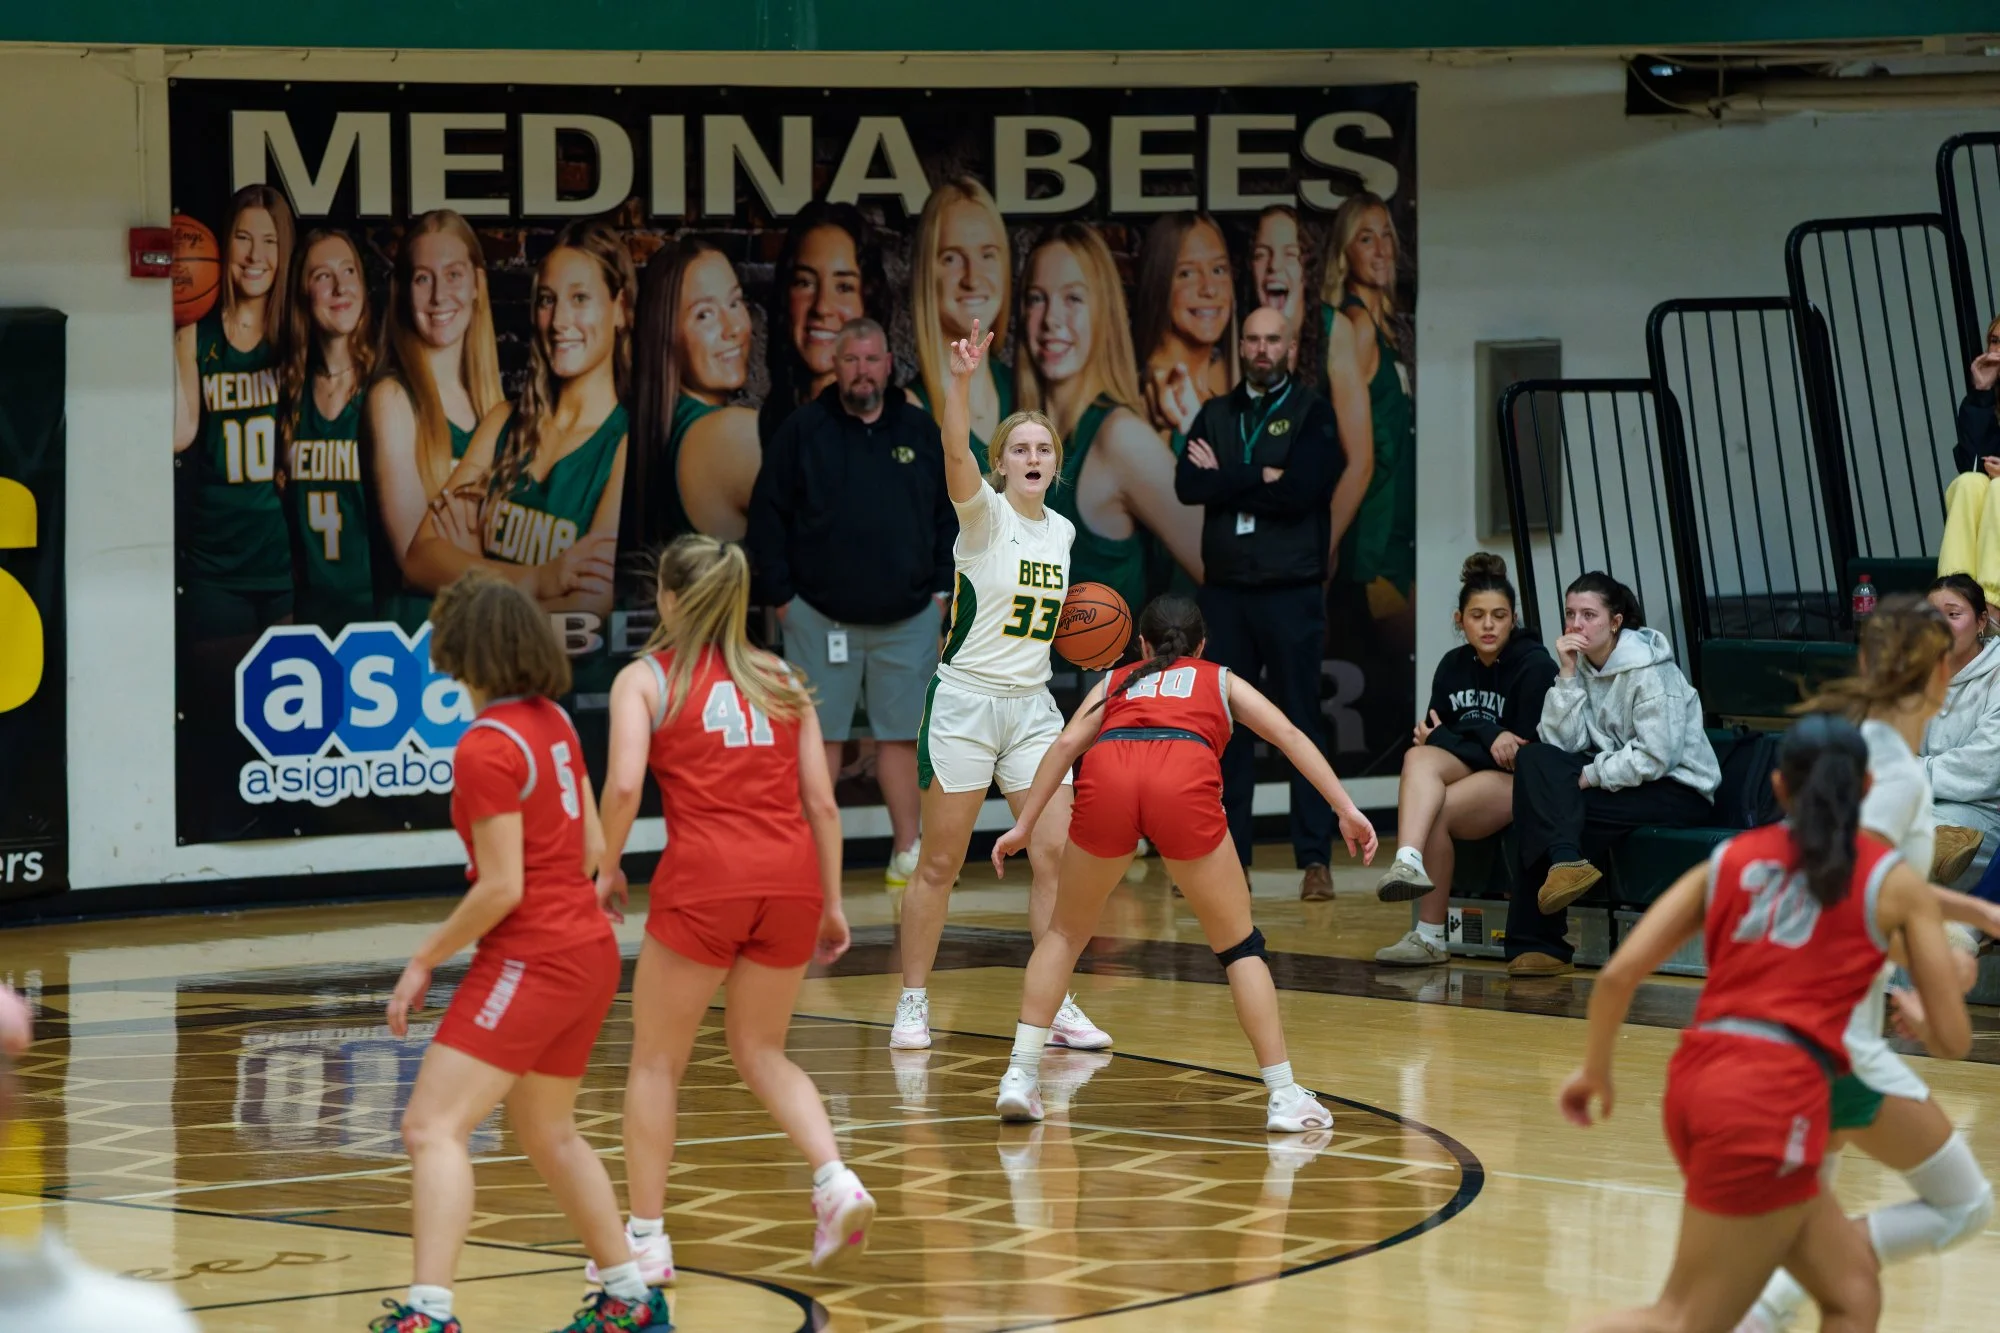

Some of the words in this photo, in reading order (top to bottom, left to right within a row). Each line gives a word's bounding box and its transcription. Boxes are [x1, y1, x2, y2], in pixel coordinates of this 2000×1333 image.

[229, 109, 931, 219] MEDINA
[993, 110, 1401, 214] BEES
[202, 367, 281, 413] MEDIN
[222, 414, 276, 485] 10
[306, 490, 343, 561] 4
[1019, 559, 1064, 590] BEES
[1002, 594, 1062, 643] 33
[263, 654, 475, 732] asa
[702, 680, 775, 748] 41
[247, 769, 271, 795] a
[282, 758, 363, 797] sign
[550, 740, 580, 820] 5
